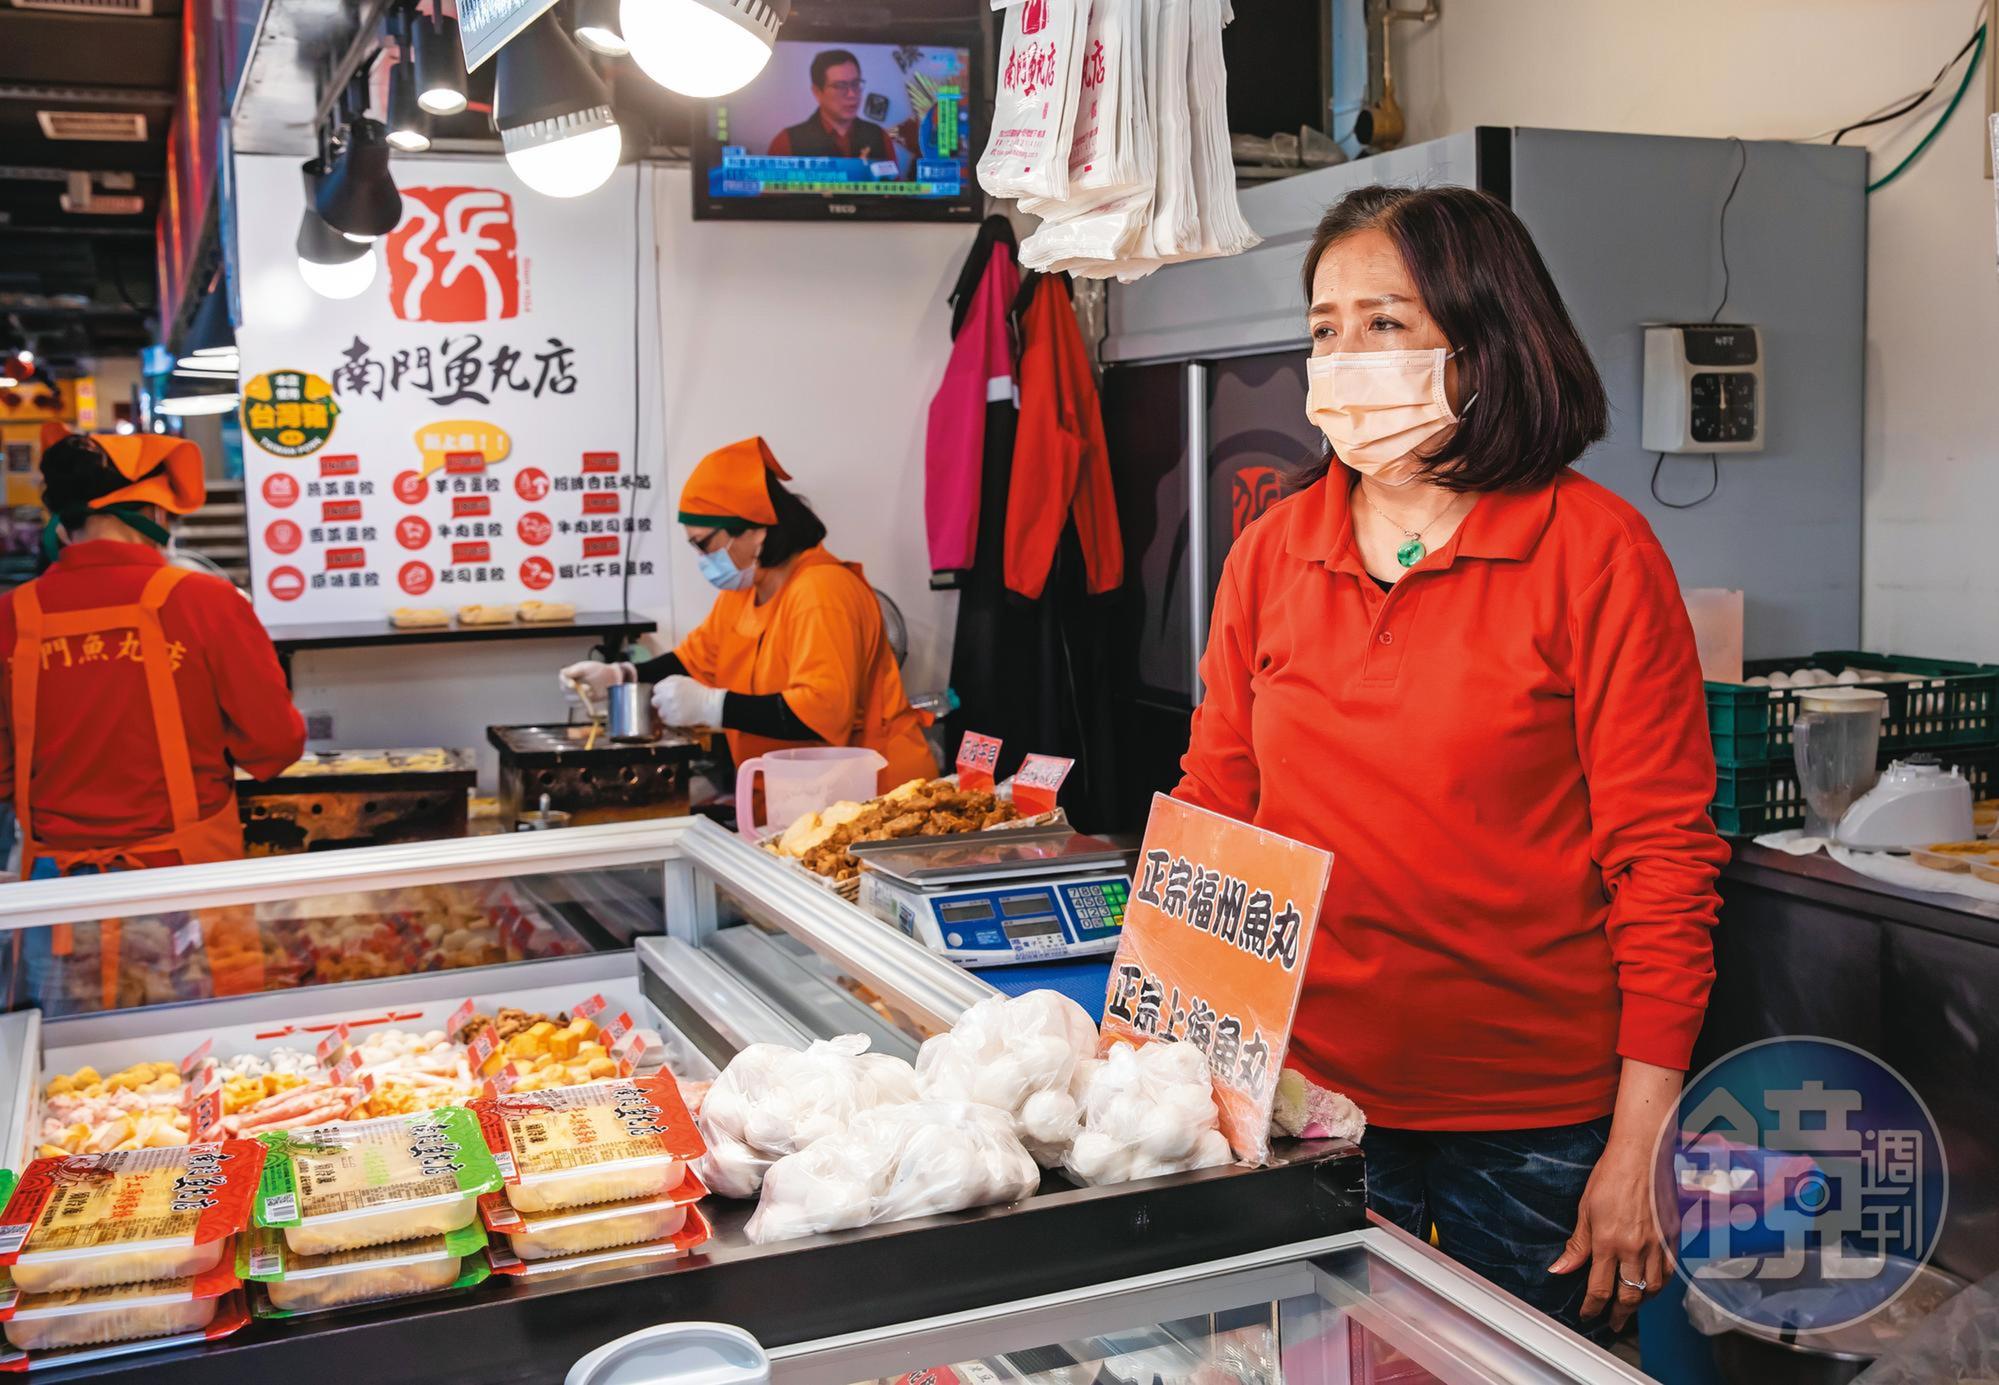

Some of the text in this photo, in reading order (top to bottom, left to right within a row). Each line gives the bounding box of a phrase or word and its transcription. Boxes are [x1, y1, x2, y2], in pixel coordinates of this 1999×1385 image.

[829, 204, 856, 213] TECO
[332, 334, 577, 406] 南門魚丸店
[1138, 849, 1302, 973] 正宗福州魚丸
[1108, 964, 1269, 1094] 正宗上海魚丸
